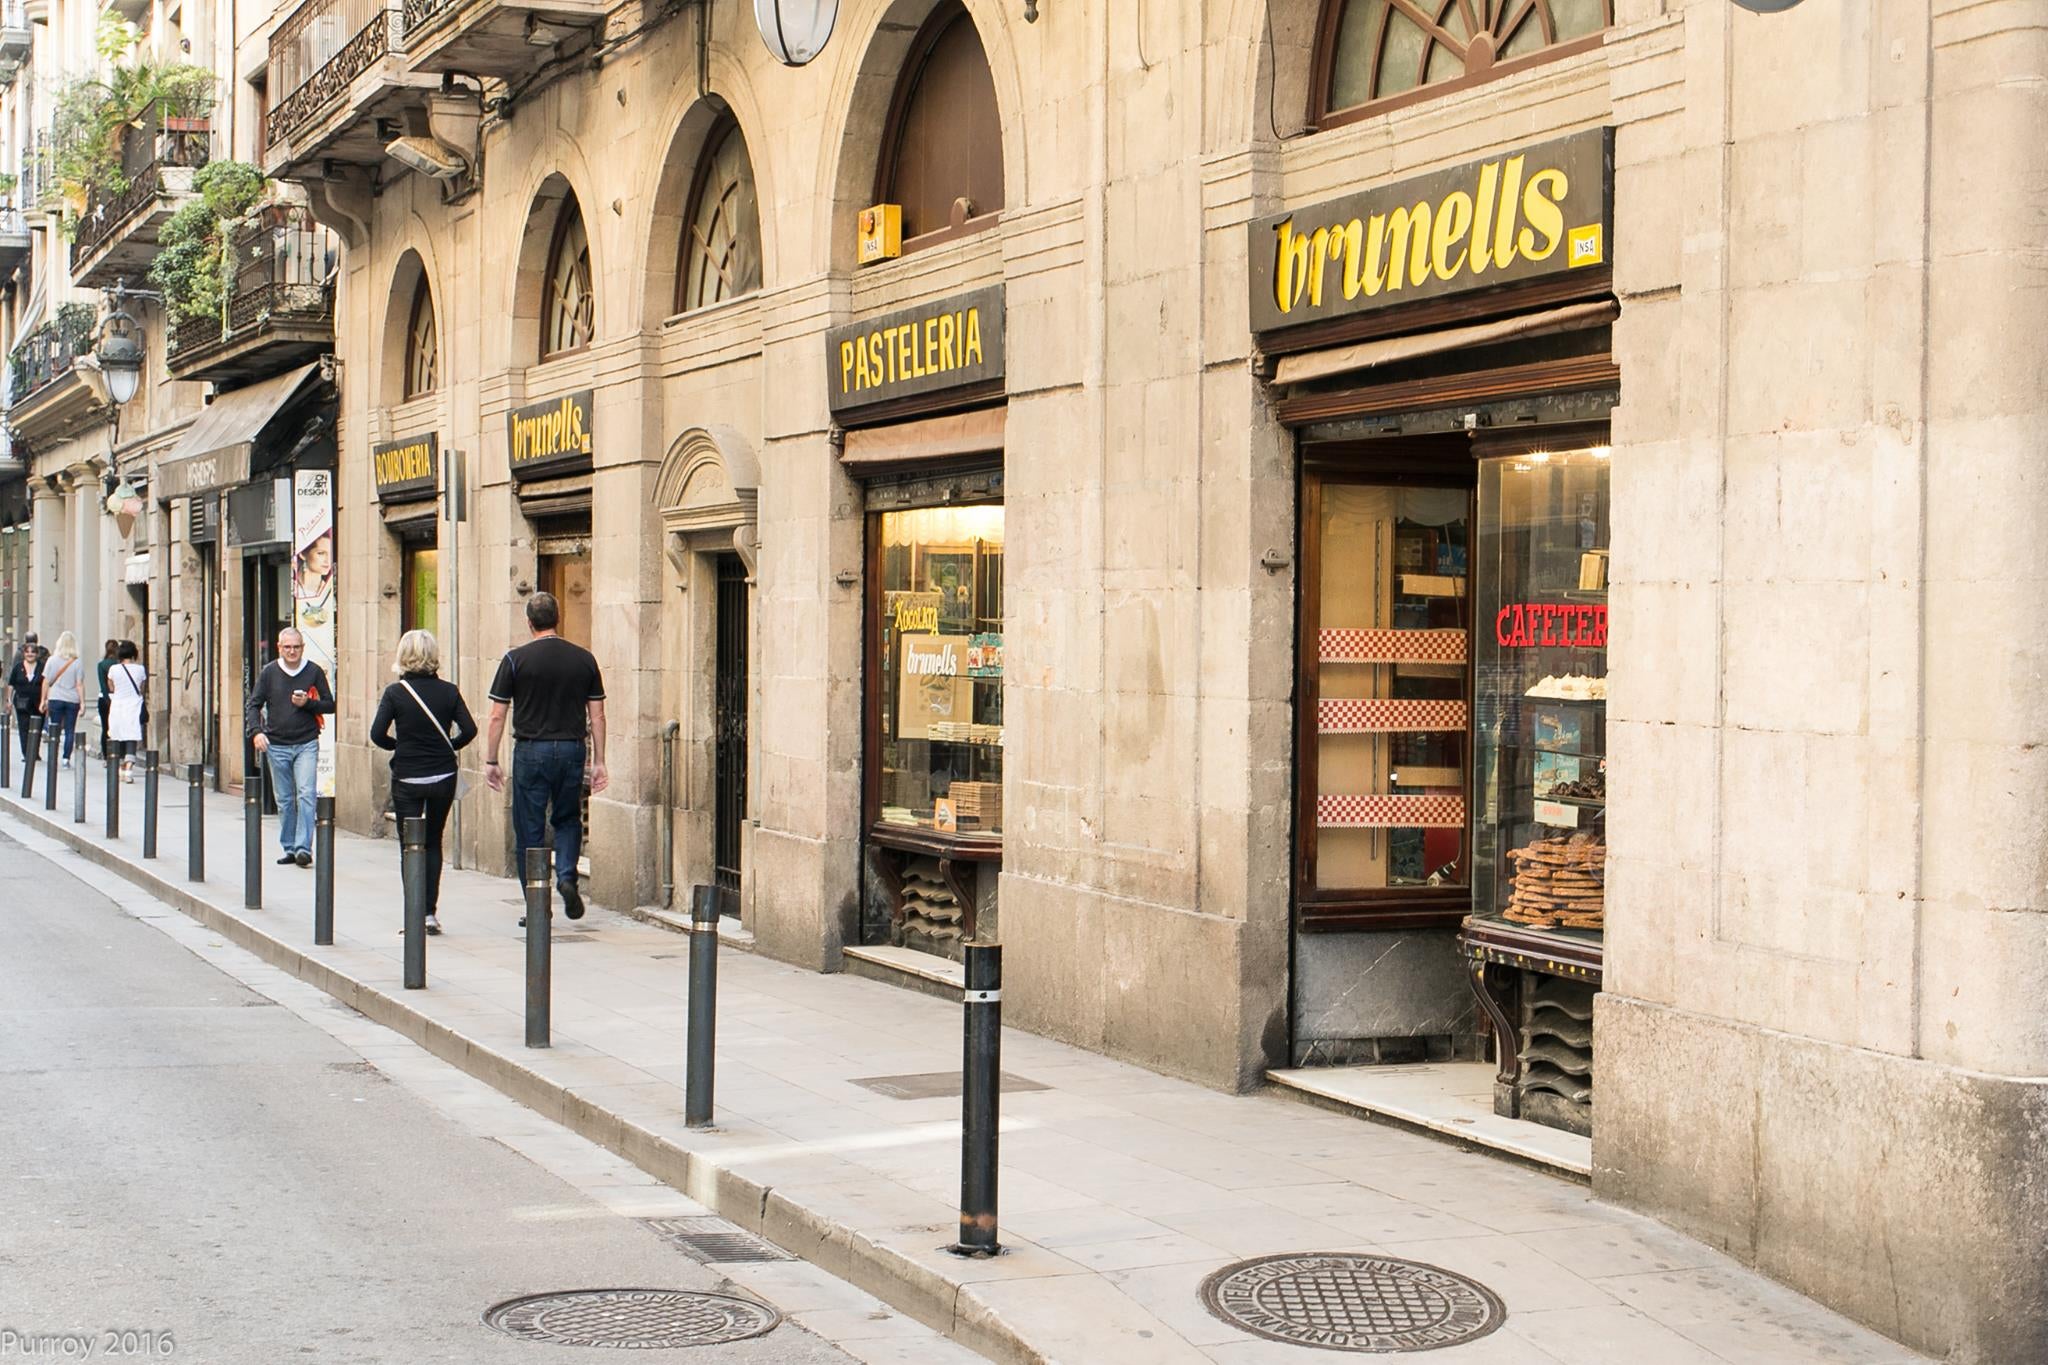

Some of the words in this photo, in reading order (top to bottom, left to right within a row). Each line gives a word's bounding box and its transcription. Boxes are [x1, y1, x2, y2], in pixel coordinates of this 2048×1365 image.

[1275, 154, 1568, 314] brunells
[841, 307, 983, 394] PASTELERIA
[512, 398, 583, 462] brunells
[376, 443, 431, 485] BOMBONERIA
[297, 488, 328, 496] DESIGN
[907, 641, 958, 676] brunells
